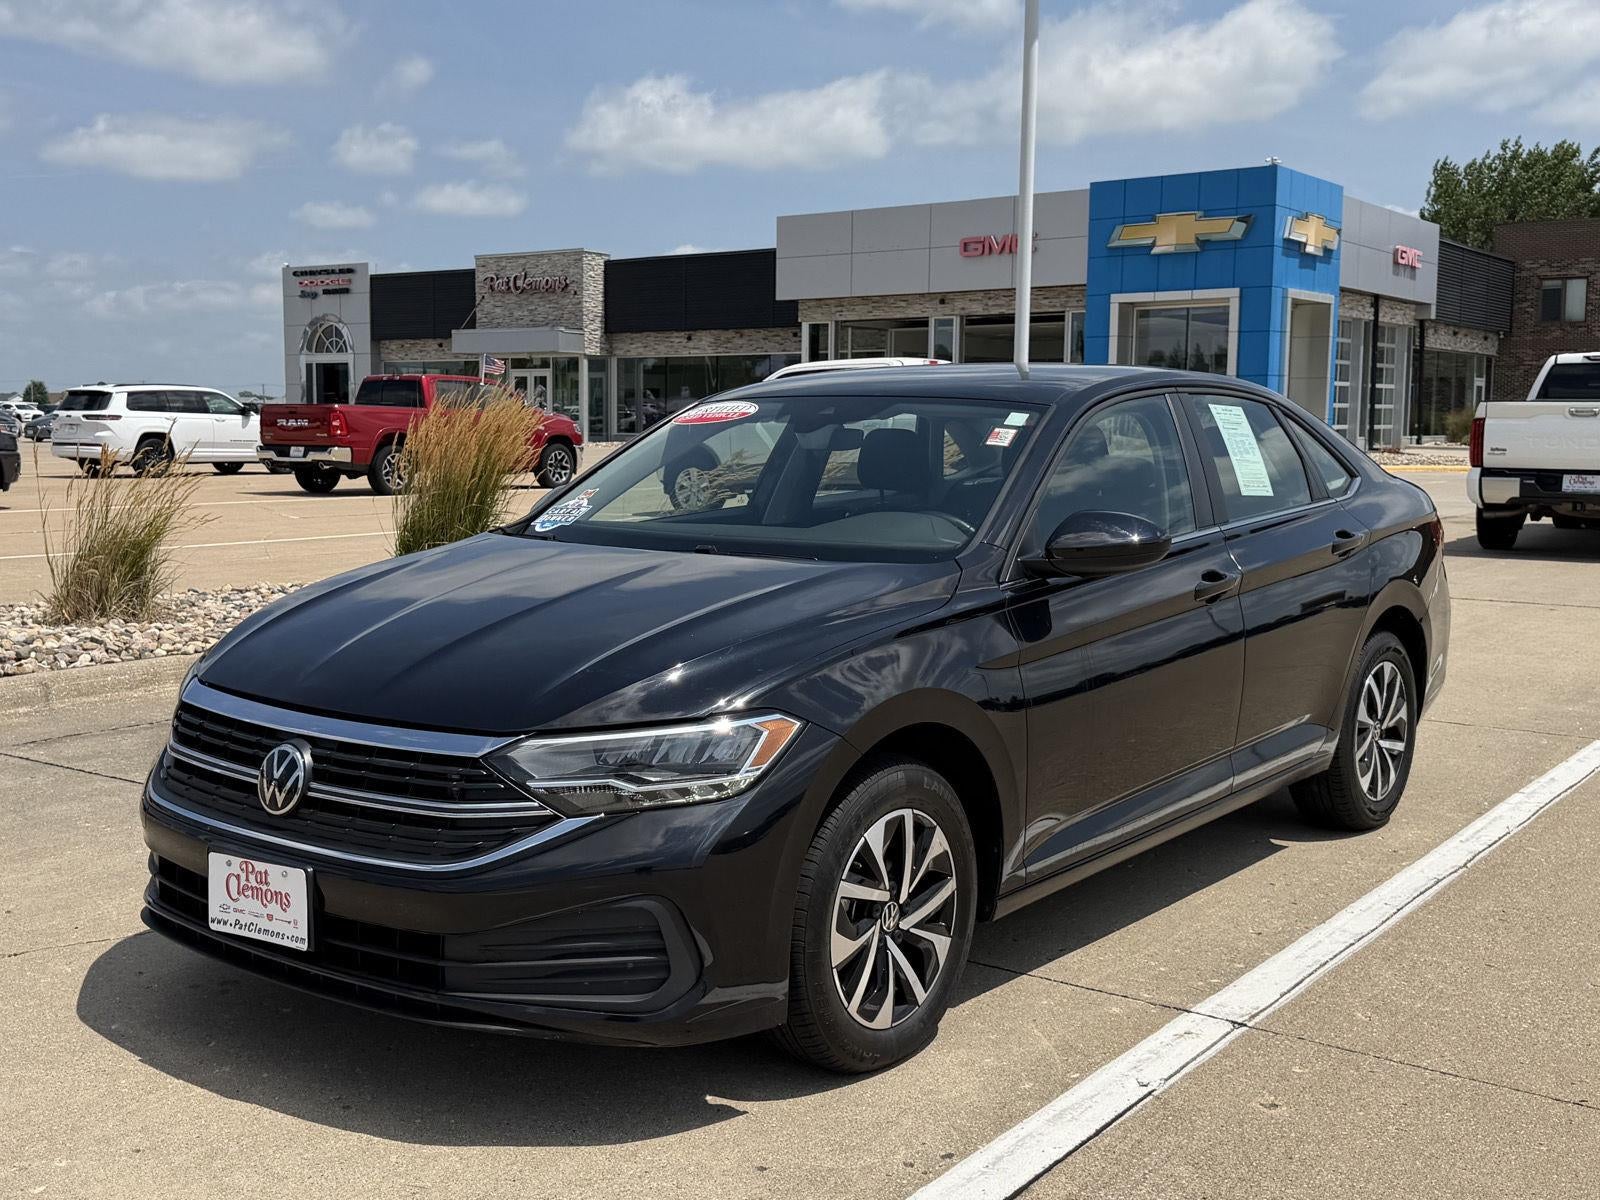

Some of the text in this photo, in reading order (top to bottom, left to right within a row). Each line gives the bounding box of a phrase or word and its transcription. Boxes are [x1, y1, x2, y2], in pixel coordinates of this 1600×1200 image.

[1396, 245, 1424, 268] GMC
[298, 278, 352, 287] DODGE
[484, 271, 569, 294] Pat Clemons
[277, 418, 309, 427] RAM
[239, 860, 271, 887] Pat
[226, 873, 292, 913] Clemons
[210, 916, 306, 946] www.PatClemons.com
